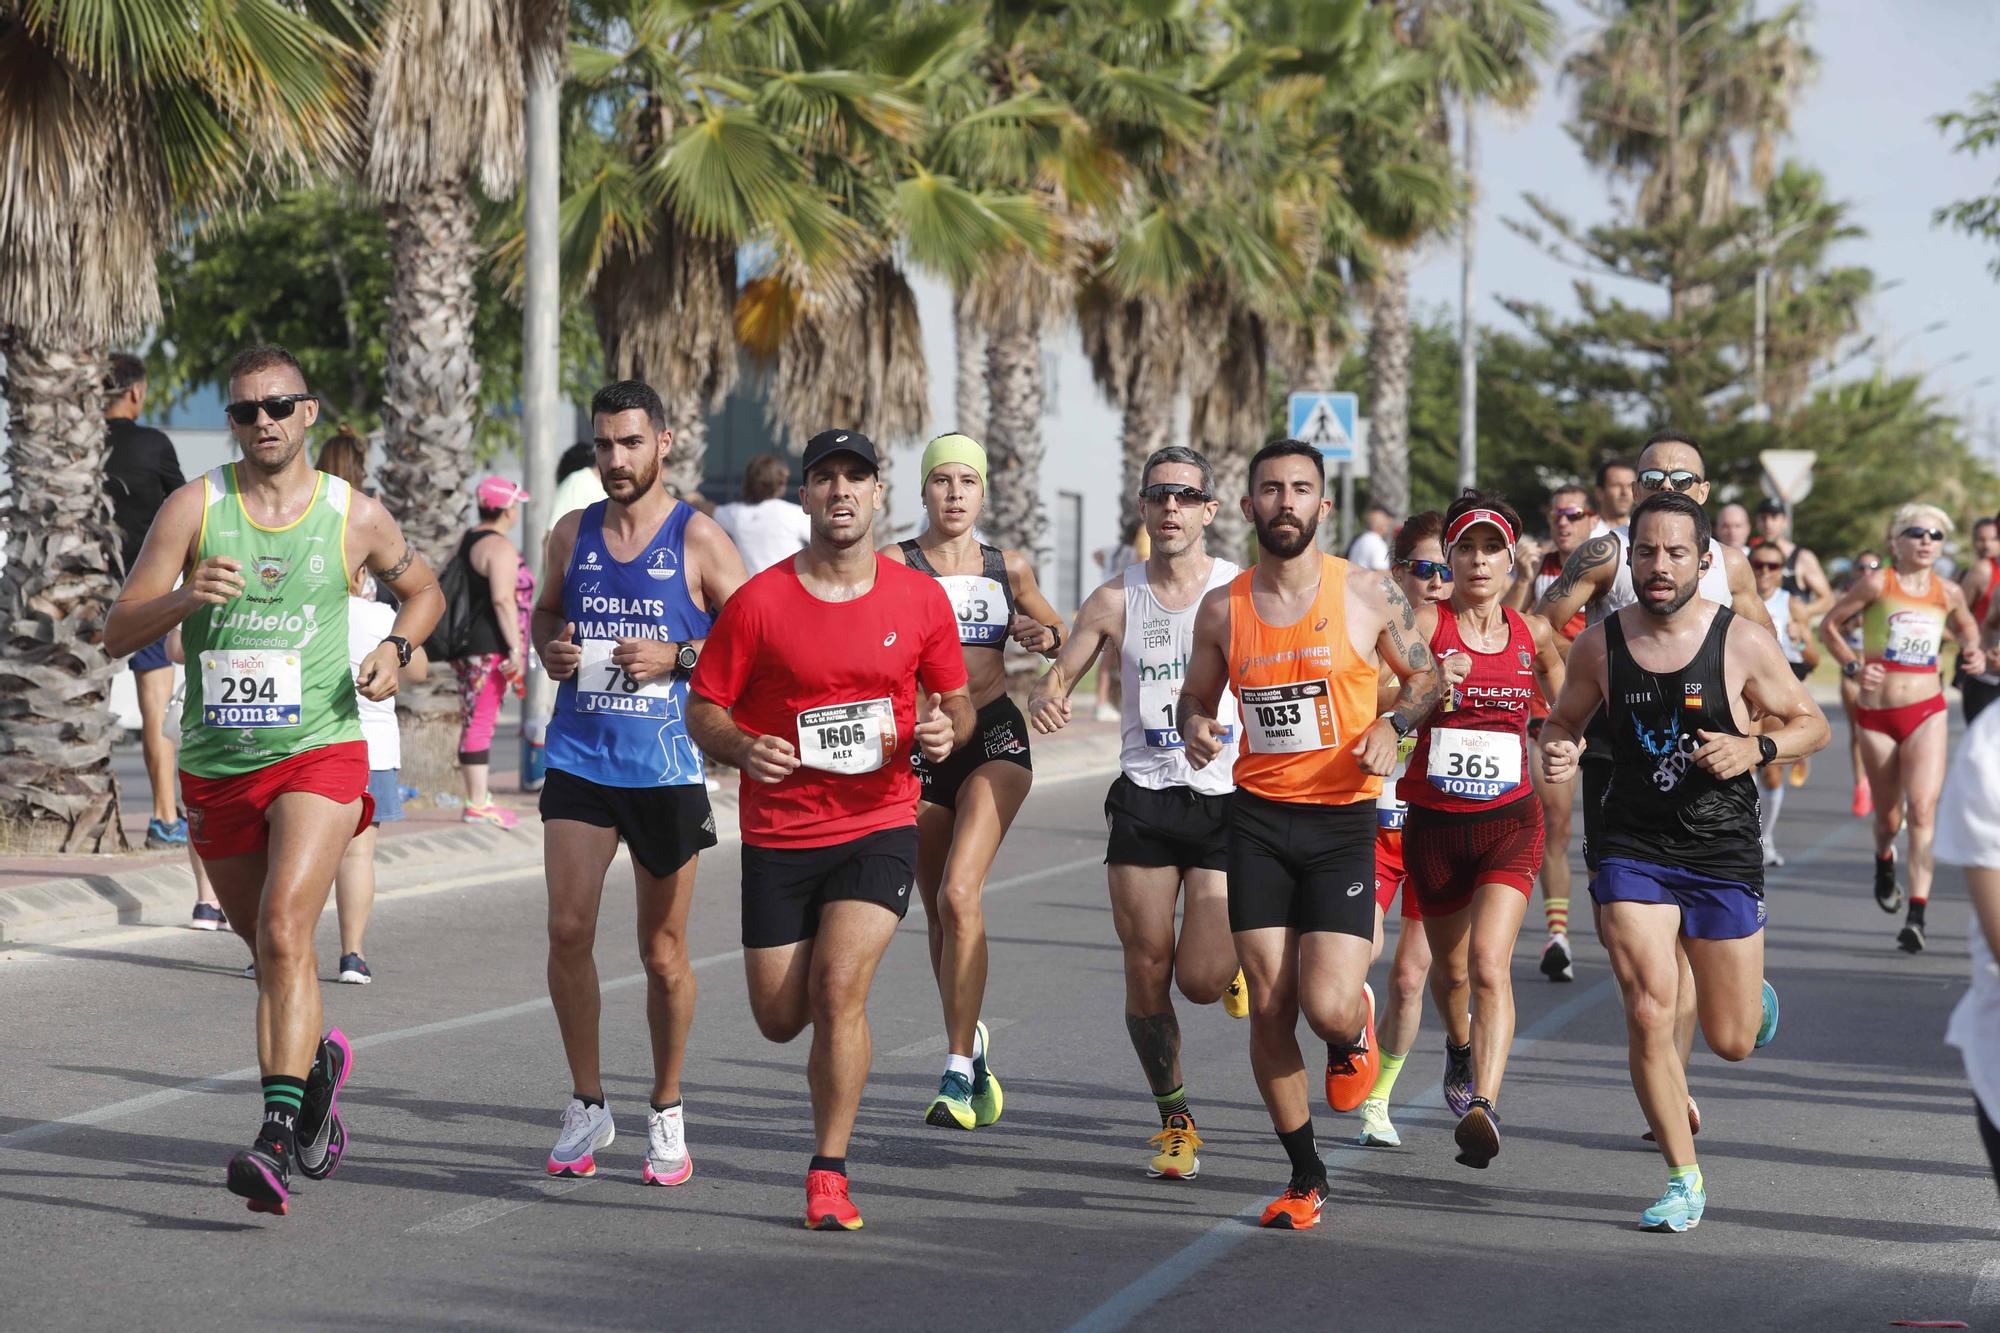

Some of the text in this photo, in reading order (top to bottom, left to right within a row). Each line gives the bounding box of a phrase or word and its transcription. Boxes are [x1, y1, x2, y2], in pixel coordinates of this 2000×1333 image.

[578, 563, 603, 571] VIATOR
[578, 581, 601, 594] C.A.
[582, 596, 664, 617] POBLATS
[210, 606, 304, 632] Curbelo
[1142, 618, 1171, 630] bathco
[578, 617, 669, 642] MARÍTIMS
[1143, 627, 1169, 637] running
[232, 633, 289, 649] Ortopedia
[1143, 635, 1171, 649] TEAM
[1902, 636, 1931, 655] 360
[604, 666, 640, 694] 78
[221, 677, 278, 704] 294
[1467, 687, 1532, 698] PUERTAS
[1684, 683, 1702, 695] ESP
[1474, 699, 1525, 711] LORCA
[1625, 692, 1652, 704] GOBIK
[1255, 703, 1302, 728] 1033
[1319, 704, 1330, 719] BOX
[816, 723, 866, 750] 1606
[1264, 728, 1295, 739] MANUEL
[832, 750, 853, 760] ALEX
[1447, 752, 1500, 779] 365
